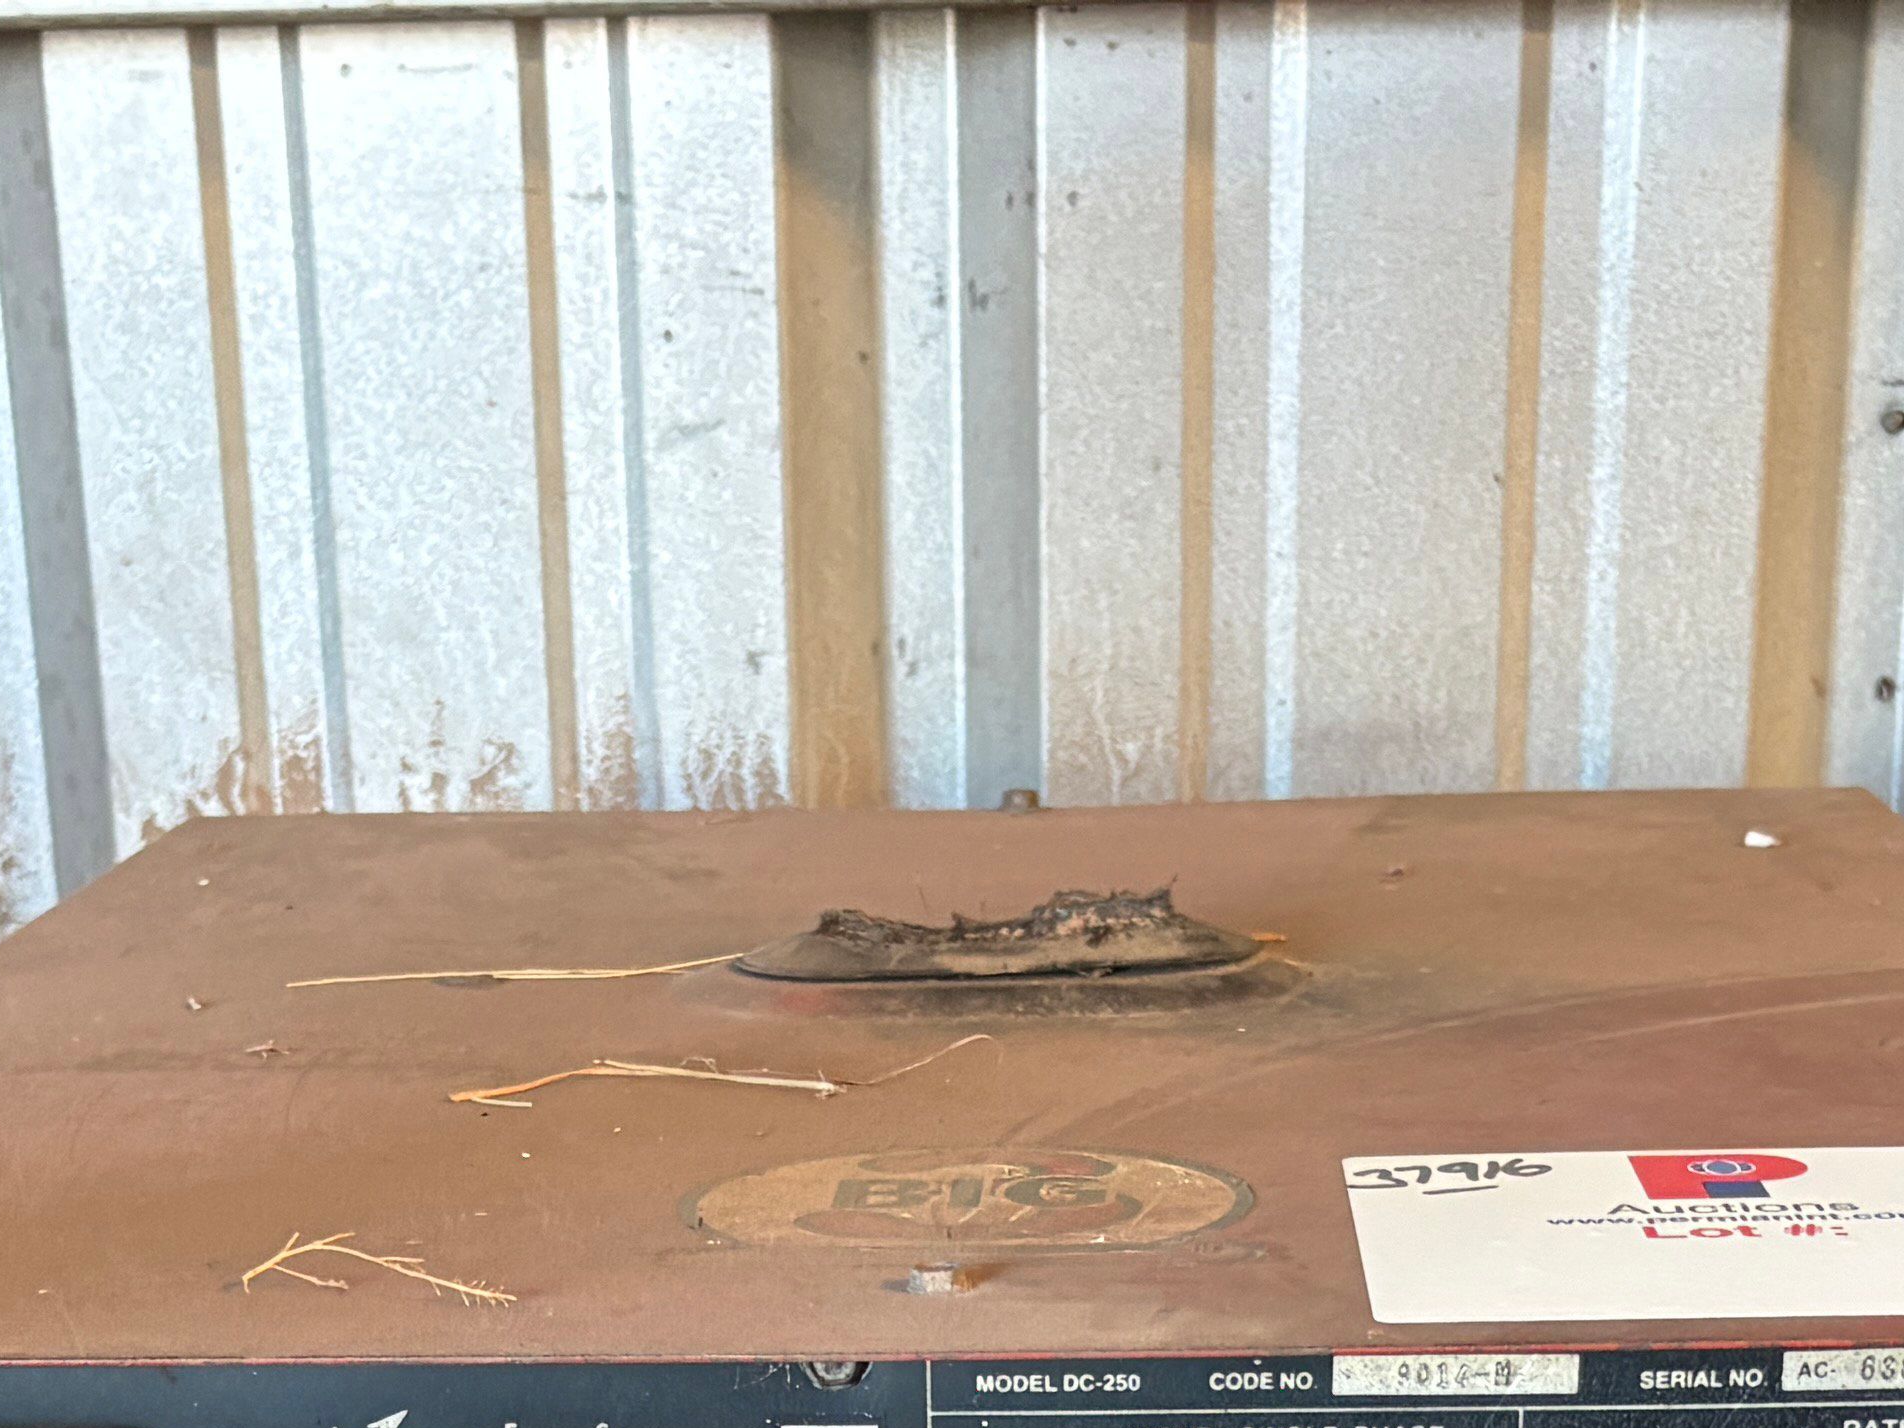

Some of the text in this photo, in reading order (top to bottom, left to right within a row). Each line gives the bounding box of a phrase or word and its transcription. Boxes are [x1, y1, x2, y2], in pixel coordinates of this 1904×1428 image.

[1348, 1158, 1553, 1191] 37916
[1608, 1203, 1860, 1216] Auctions
[1641, 1225, 1762, 1240] Lot
[977, 1374, 1140, 1392] MODEL DC-250
[1209, 1372, 1318, 1390] CODE NO.
[1640, 1369, 1767, 1389] SERIAL NO.
